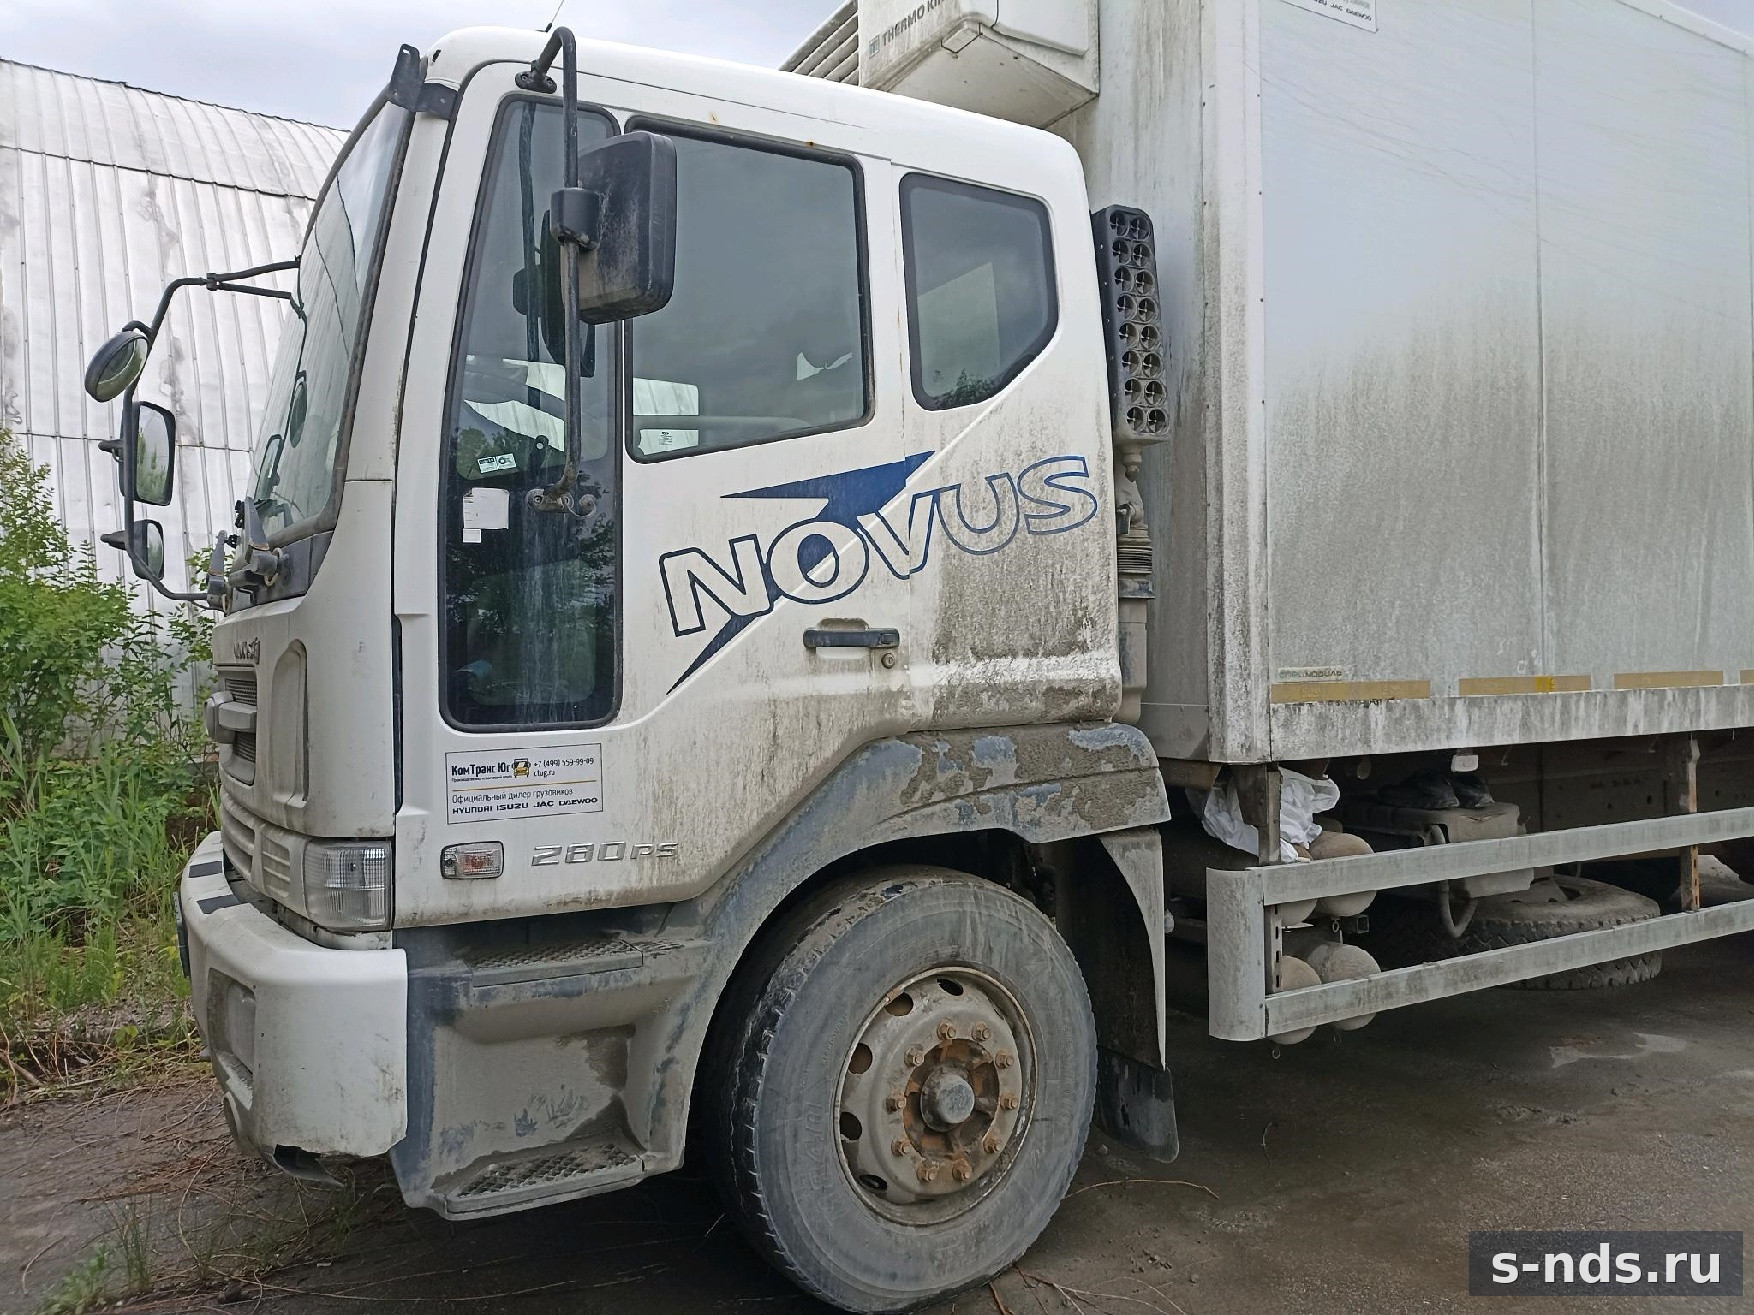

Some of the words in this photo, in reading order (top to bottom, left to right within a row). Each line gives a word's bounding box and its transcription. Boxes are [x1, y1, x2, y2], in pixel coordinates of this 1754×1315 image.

[882, 4, 925, 46] THERMO
[659, 455, 1098, 637] NOVUS
[498, 762, 511, 773] Юг
[452, 791, 507, 805] Официальный
[508, 789, 531, 801] дилер
[452, 805, 493, 815] HYUNDAI
[496, 802, 529, 812] ISUZU
[533, 800, 555, 808] JAC
[558, 797, 598, 807] DAEWOO
